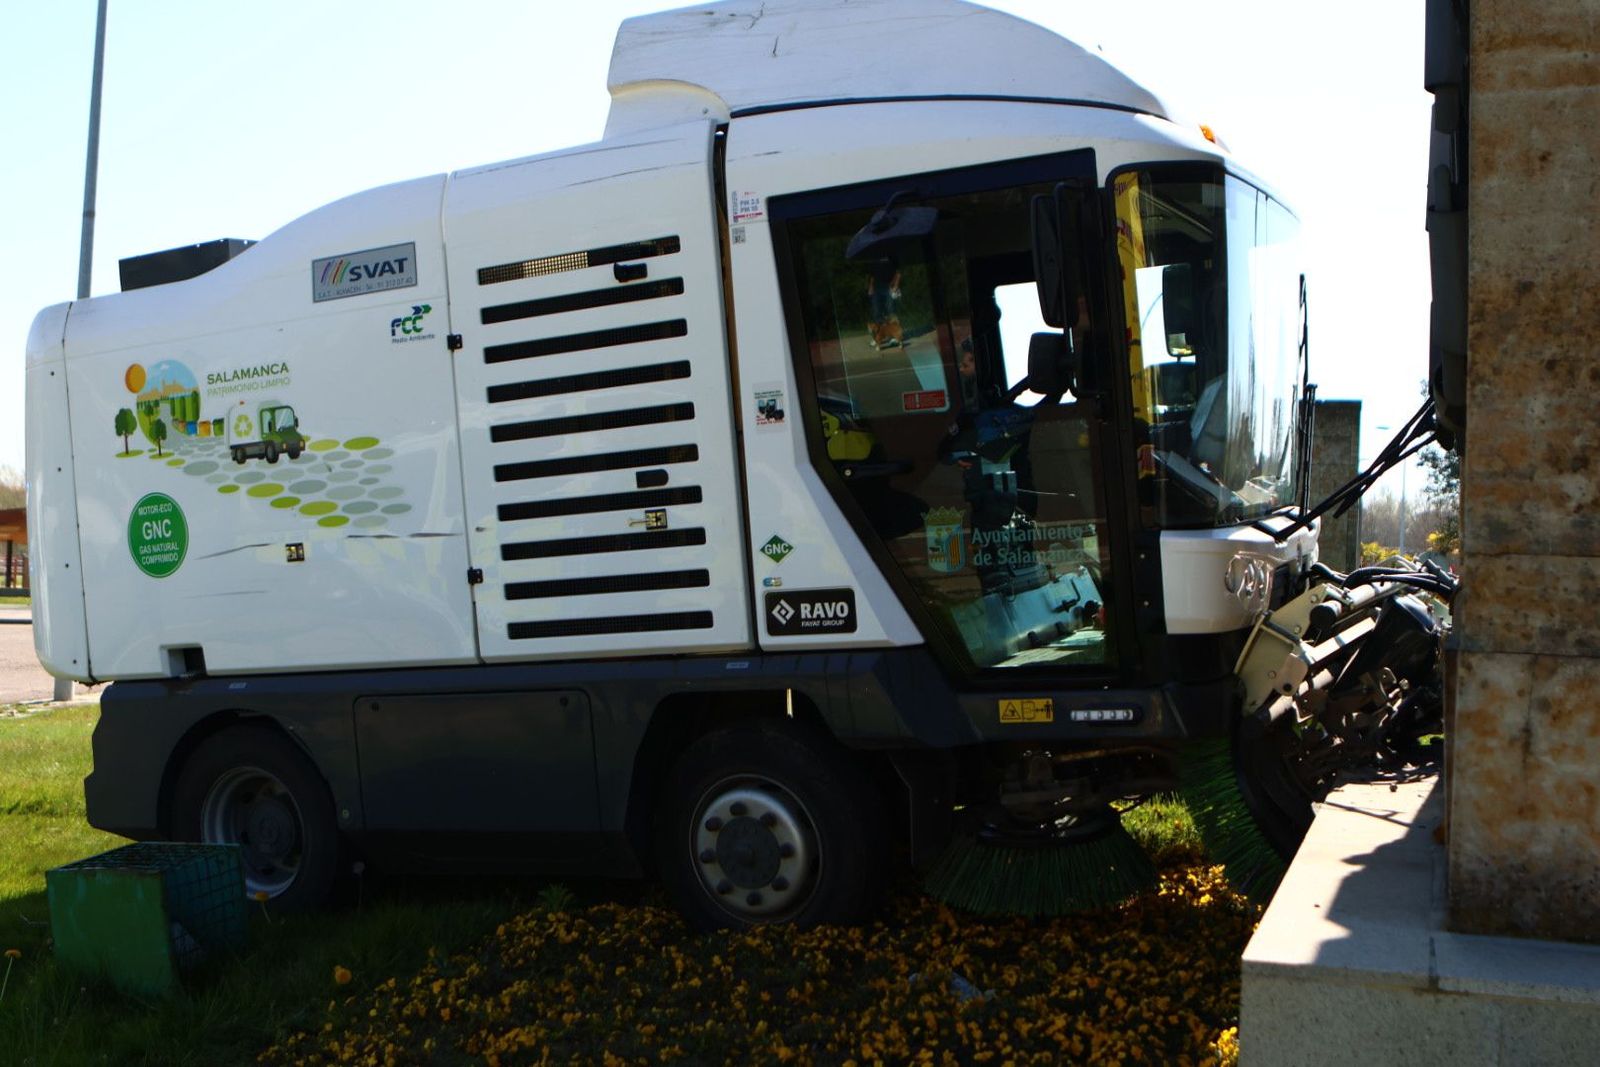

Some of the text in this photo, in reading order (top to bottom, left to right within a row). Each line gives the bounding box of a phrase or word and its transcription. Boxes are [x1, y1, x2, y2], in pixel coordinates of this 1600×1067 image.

[349, 257, 408, 282] SVAT
[391, 315, 423, 337] FCC
[207, 362, 289, 385] SALAMANCA
[207, 377, 291, 397] PATRIMONIO LIMPIO
[142, 518, 172, 540] GNC
[971, 525, 1082, 547] Ayuntamiento
[139, 541, 179, 555] GAS NATURAL
[764, 543, 789, 555] GNC
[973, 549, 993, 567] de
[141, 552, 179, 565] COMPRIMIDO
[800, 601, 849, 619] RAVO
